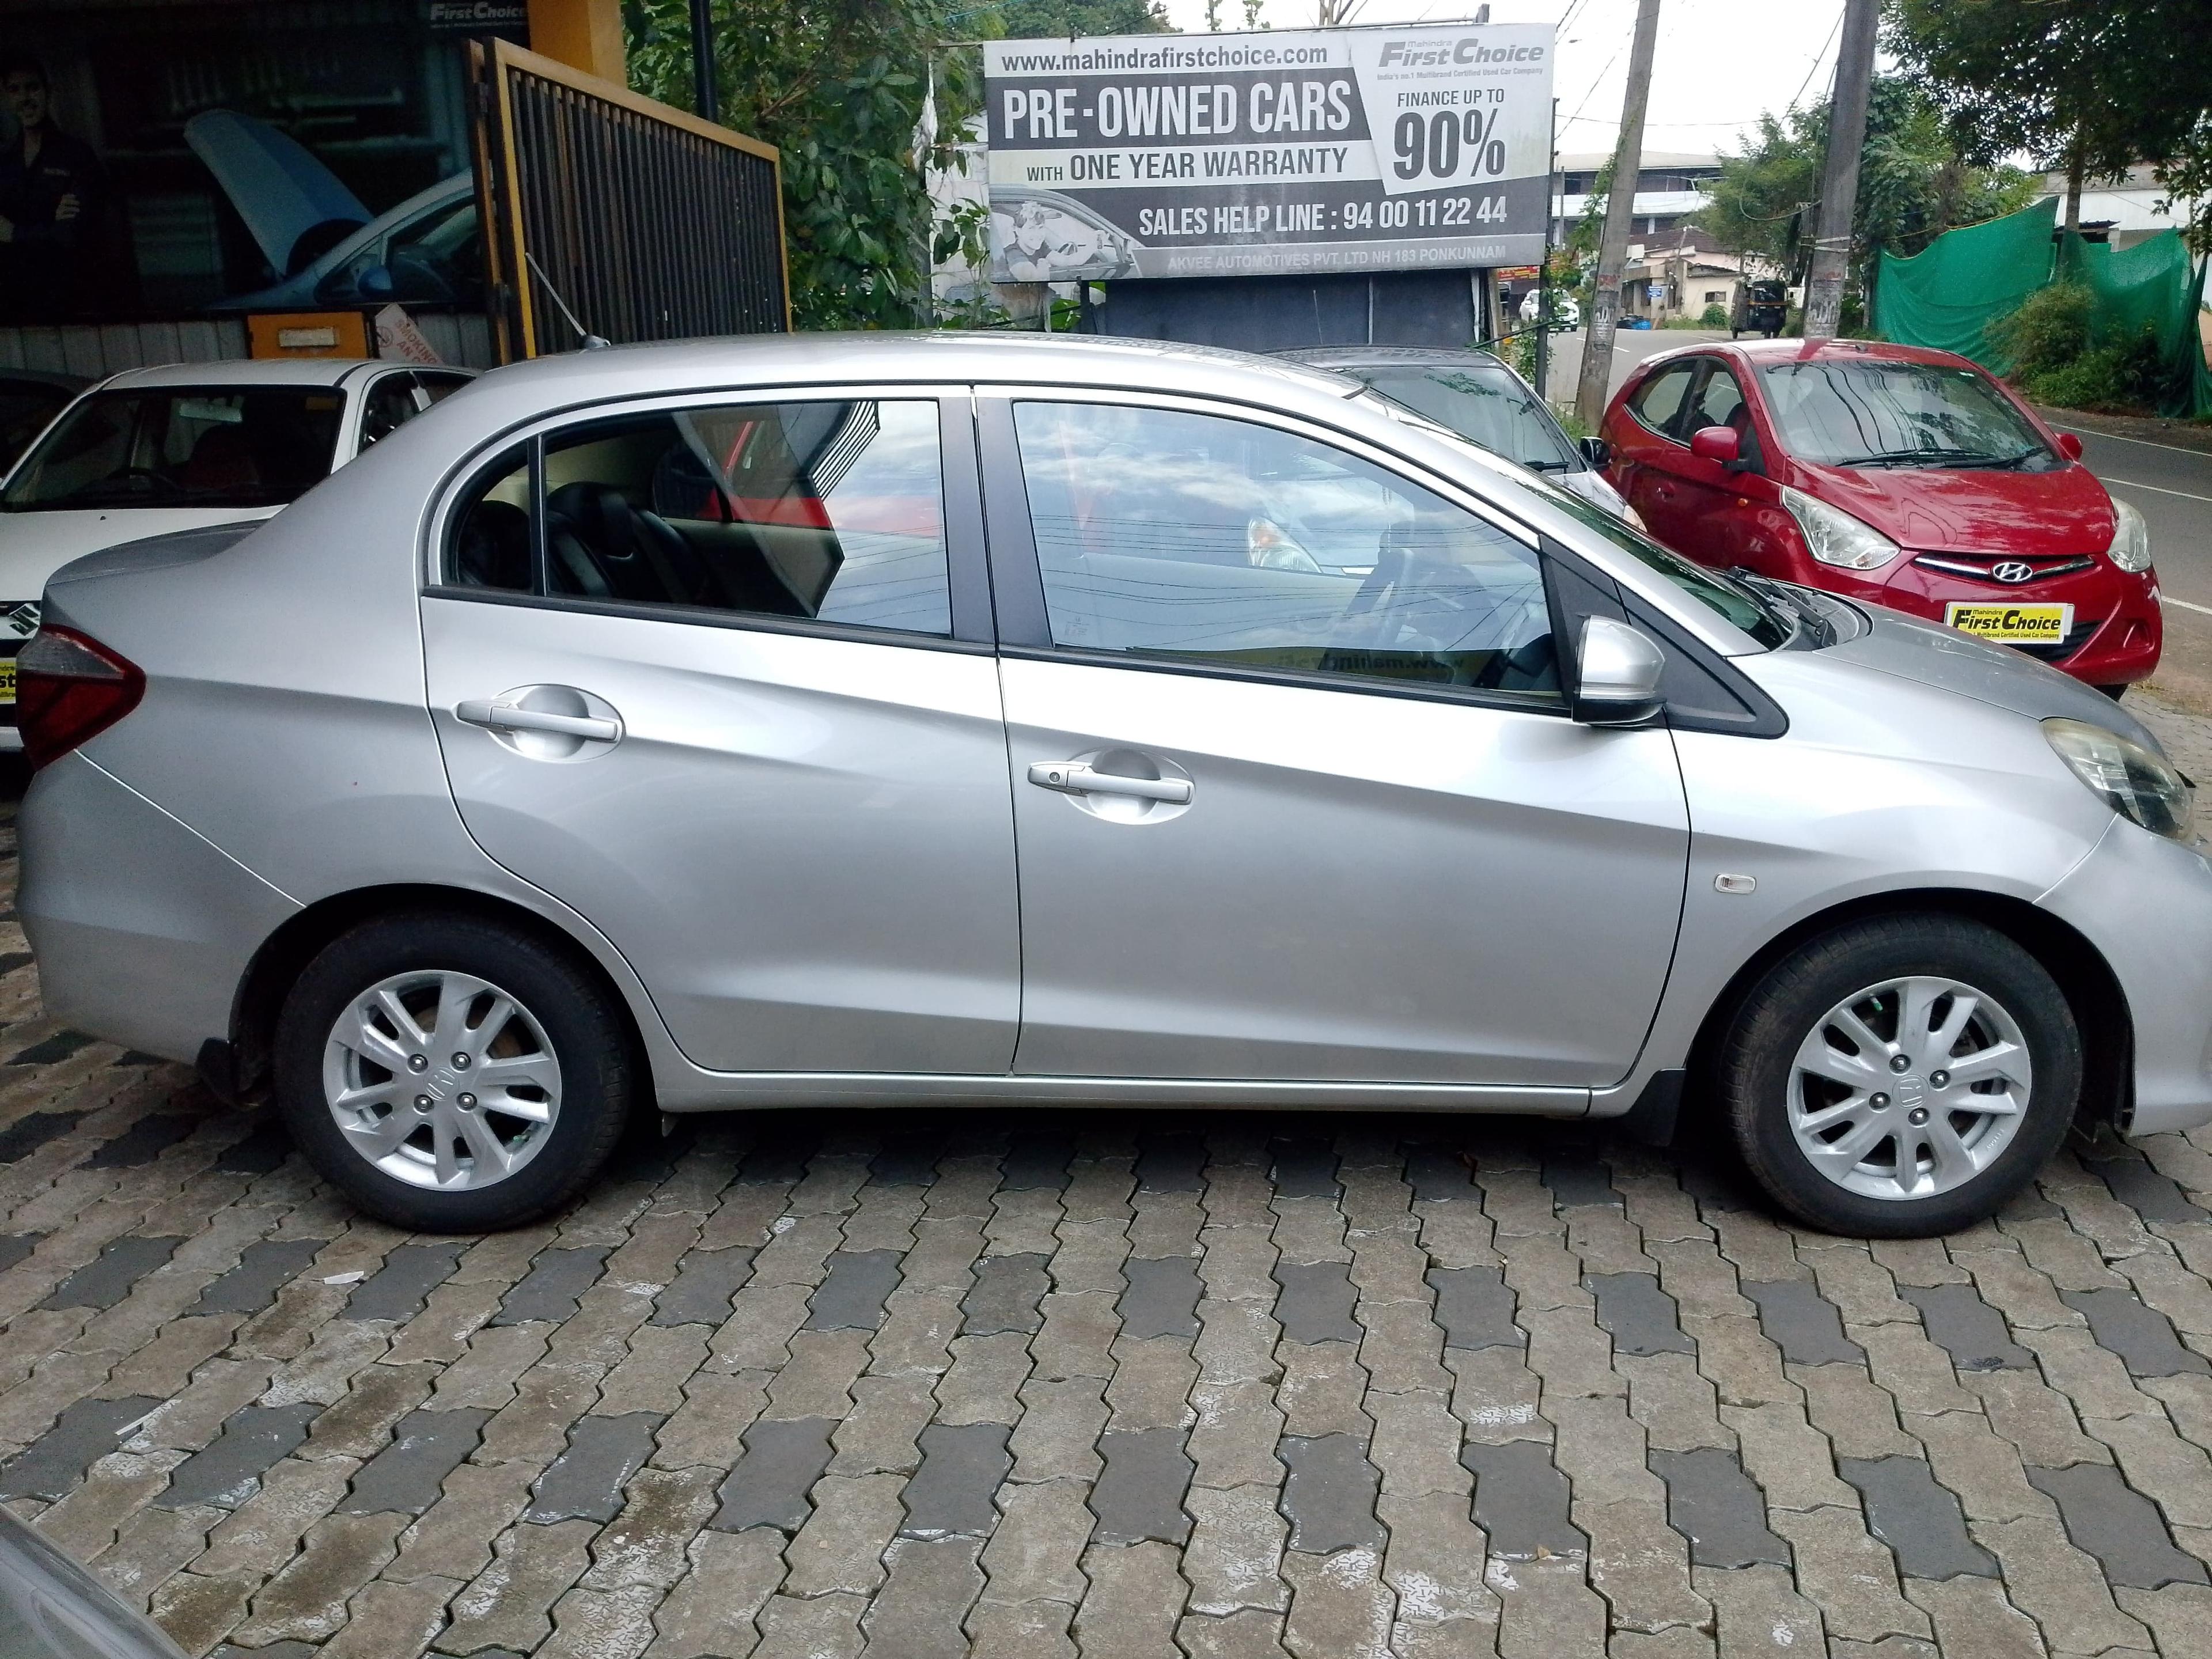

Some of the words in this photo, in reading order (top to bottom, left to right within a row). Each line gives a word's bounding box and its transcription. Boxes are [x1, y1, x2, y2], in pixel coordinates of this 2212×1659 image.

[1002, 45, 1327, 71] www.mahindrafirstchoice.com
[1378, 41, 1450, 67] First
[1453, 38, 1544, 64] Choice
[1513, 67, 1543, 75] Company
[1249, 80, 1351, 133] CARS
[1397, 90, 1459, 107] FINANCE
[1463, 89, 1482, 104] UP
[1486, 88, 1505, 103] TO
[1393, 108, 1505, 180] 90%
[1027, 166, 1063, 181] WITH
[1070, 154, 1120, 180] ONE
[1128, 153, 1195, 179] YEAR
[1203, 147, 1348, 177] WARRANTY
[1139, 207, 1208, 236] SALES
[1214, 205, 1270, 233] HELP
[1343, 202, 1373, 229] 94
[1379, 200, 1409, 228] 00
[1415, 199, 1437, 226] 11
[1442, 198, 1471, 225] 22
[1476, 196, 1508, 224] 44
[1168, 256, 1213, 270] AKVEE
[1215, 253, 1310, 269] AUTOMOTIVES
[1313, 252, 1340, 265] PVT.
[1344, 251, 1369, 264] LTD
[1372, 251, 1389, 263] NH
[1395, 249, 1416, 262] 183
[1419, 245, 1506, 261] PONKUNNAM
[1953, 609, 2001, 629] First
[2002, 609, 2061, 630] Choice
